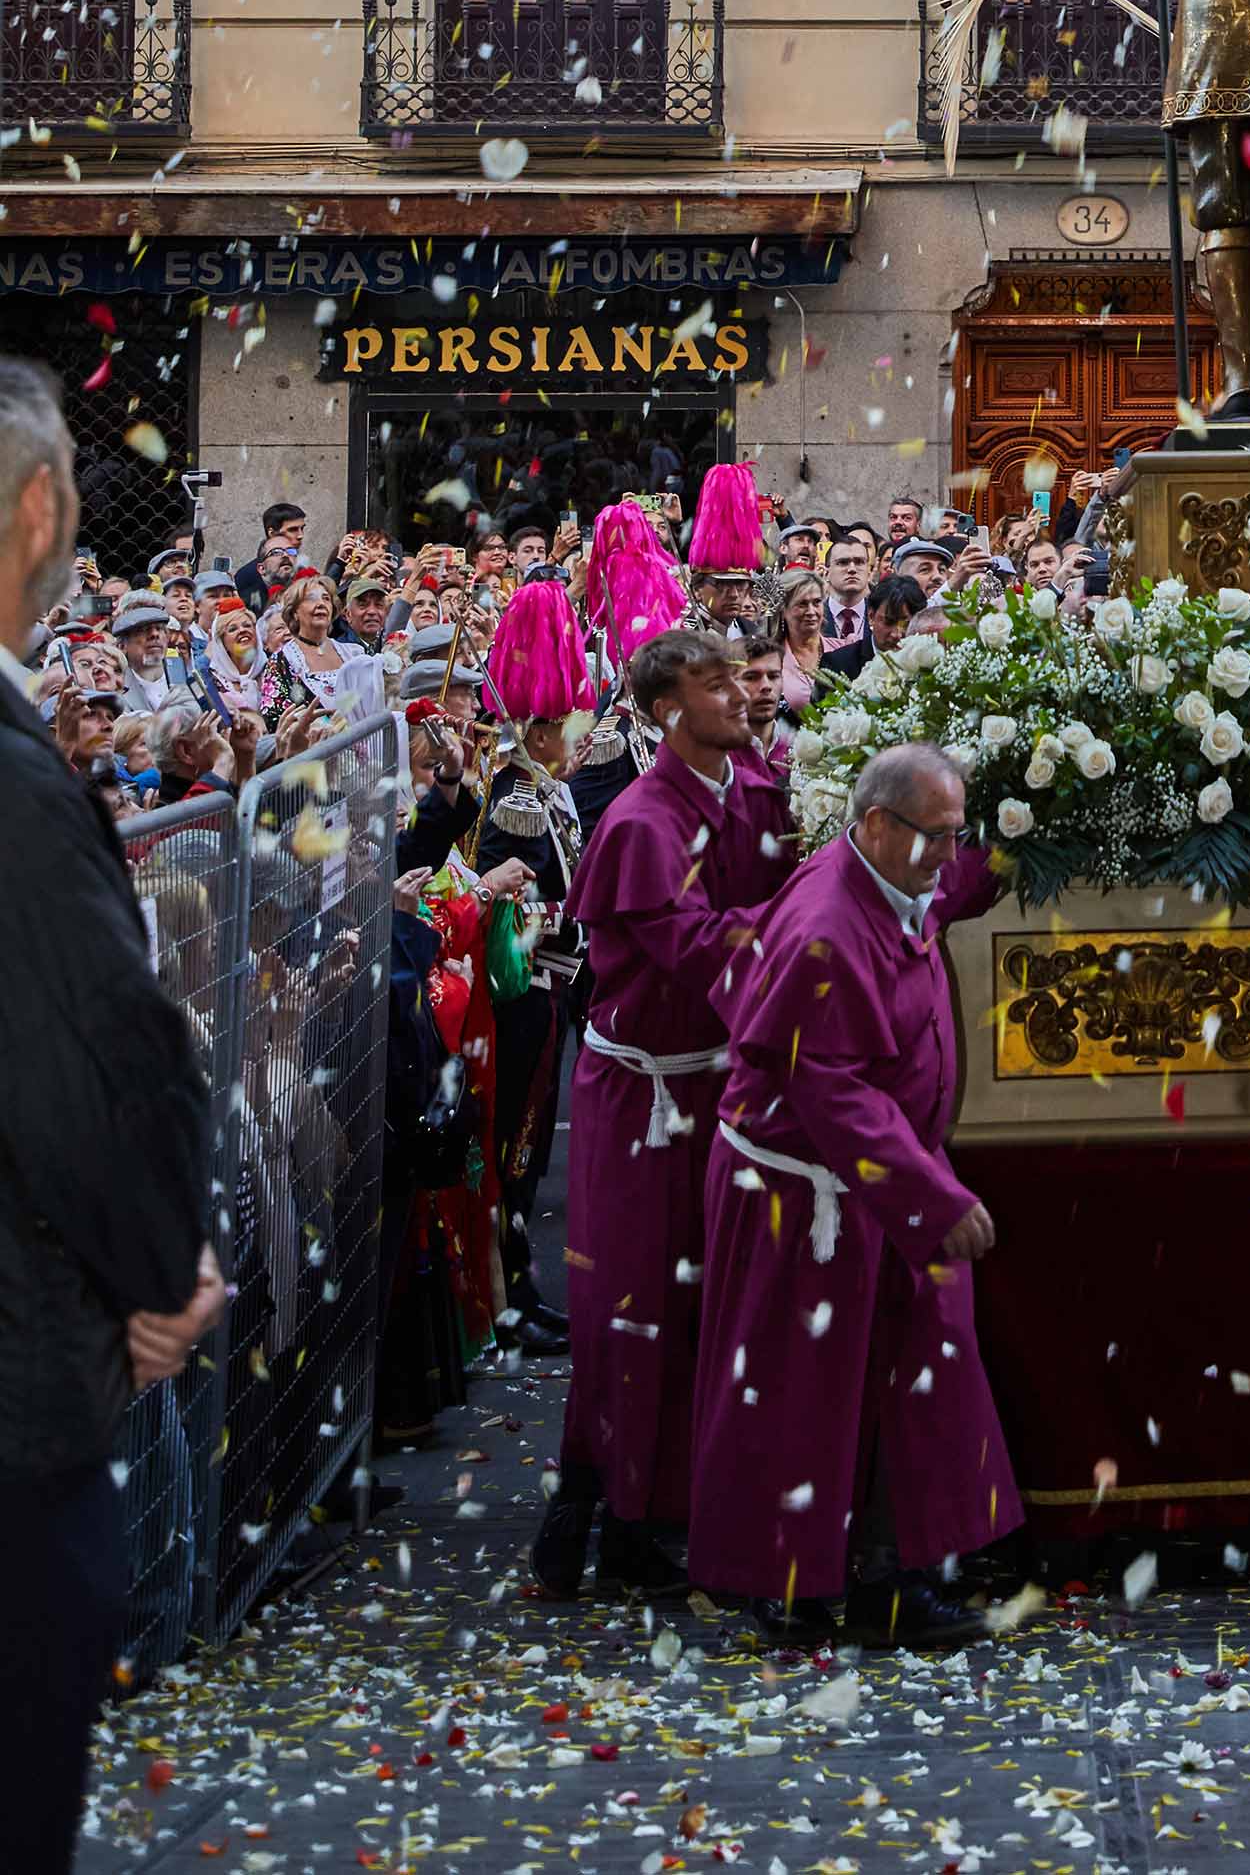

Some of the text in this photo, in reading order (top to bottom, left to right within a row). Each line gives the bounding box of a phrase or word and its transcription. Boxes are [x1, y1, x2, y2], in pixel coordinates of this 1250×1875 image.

[1073, 206, 1111, 234] 34
[165, 251, 404, 286] ESTERAS
[501, 247, 785, 284] ALFOMBRAS
[343, 325, 750, 373] PERSIANAS
